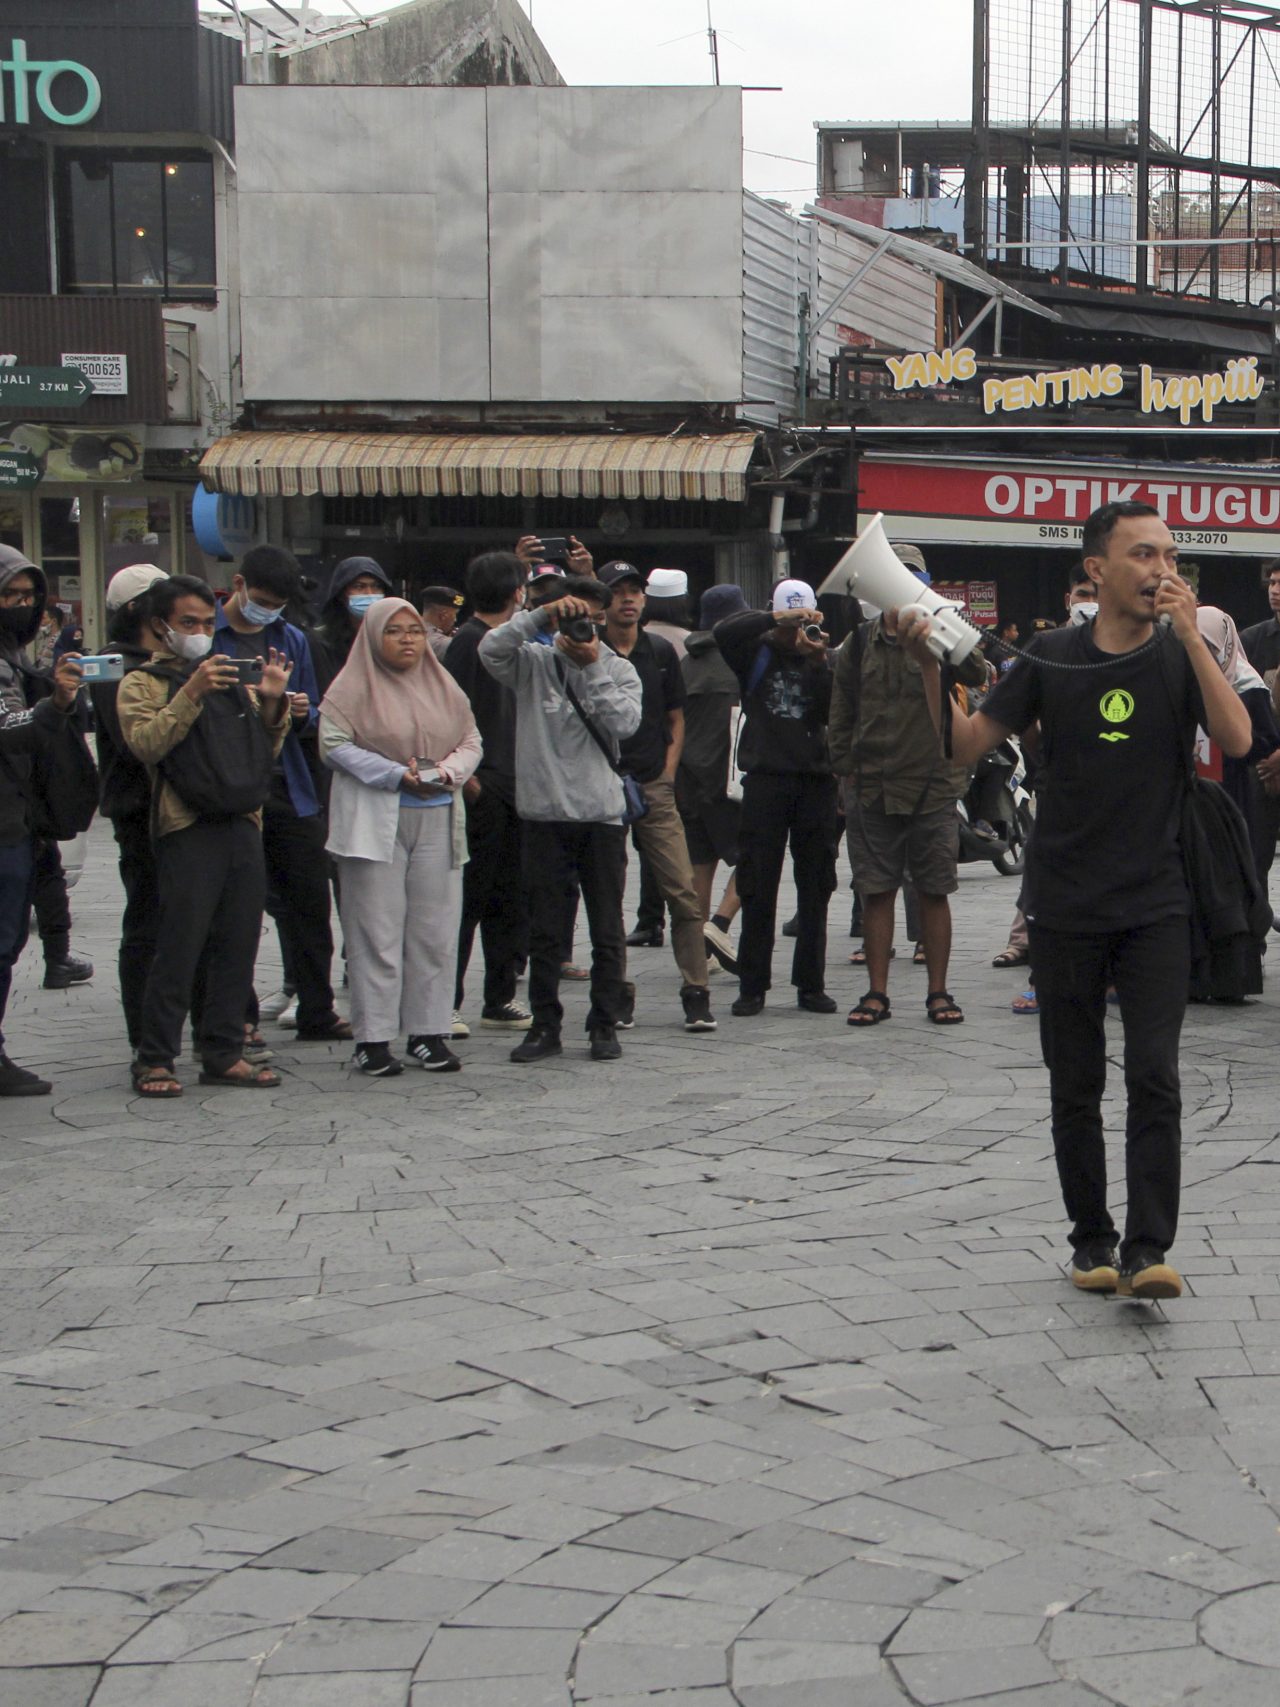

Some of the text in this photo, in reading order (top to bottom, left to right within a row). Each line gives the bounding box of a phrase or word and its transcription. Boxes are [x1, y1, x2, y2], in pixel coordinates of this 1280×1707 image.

[0, 39, 101, 124] to
[40, 383, 52, 391] 3.7
[55, 383, 69, 391] KM
[885, 347, 977, 390] YANG
[983, 364, 1124, 415] PENTING
[984, 475, 1280, 525] OPTIK TUGU
[1039, 526, 1069, 539] SMS
